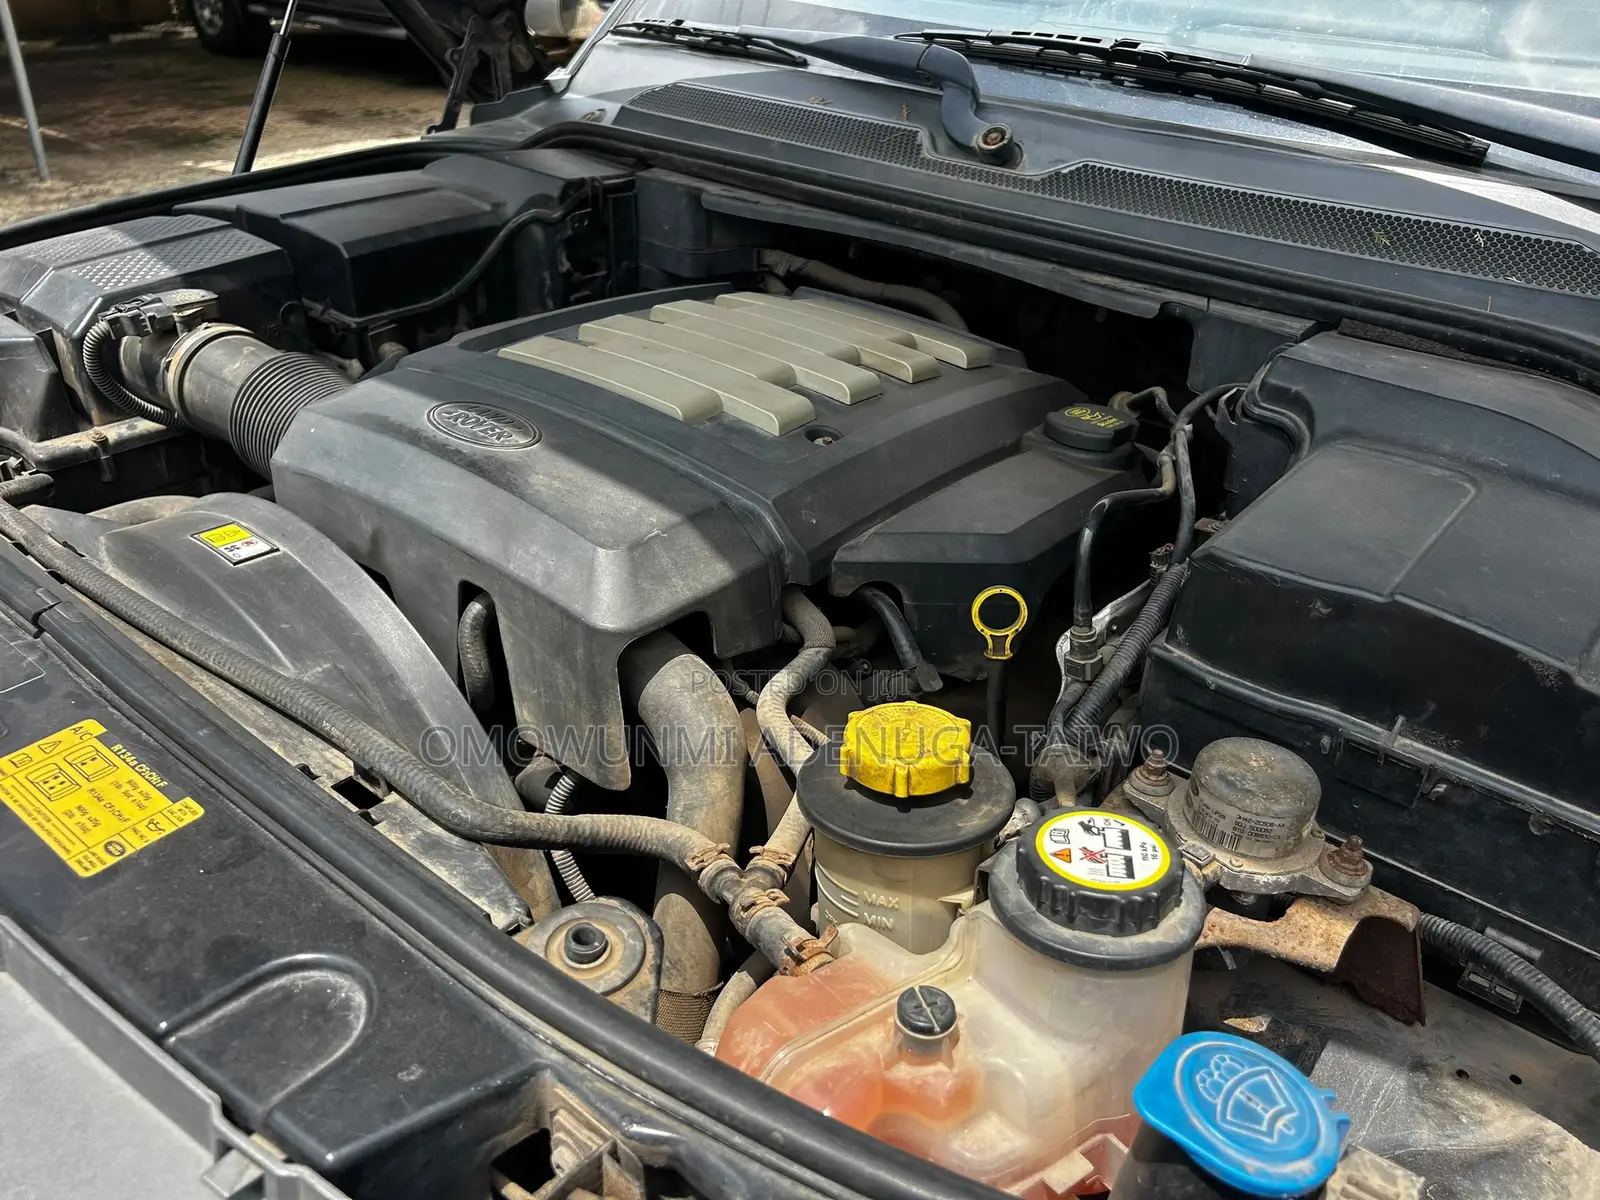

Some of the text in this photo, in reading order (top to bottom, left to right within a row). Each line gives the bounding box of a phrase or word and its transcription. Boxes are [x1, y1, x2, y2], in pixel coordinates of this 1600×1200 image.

[444, 409, 515, 442] ROVER
[69, 726, 93, 741] A/C
[110, 743, 138, 766] R134a
[863, 890, 899, 911] MAX
[863, 912, 894, 930] MIN
